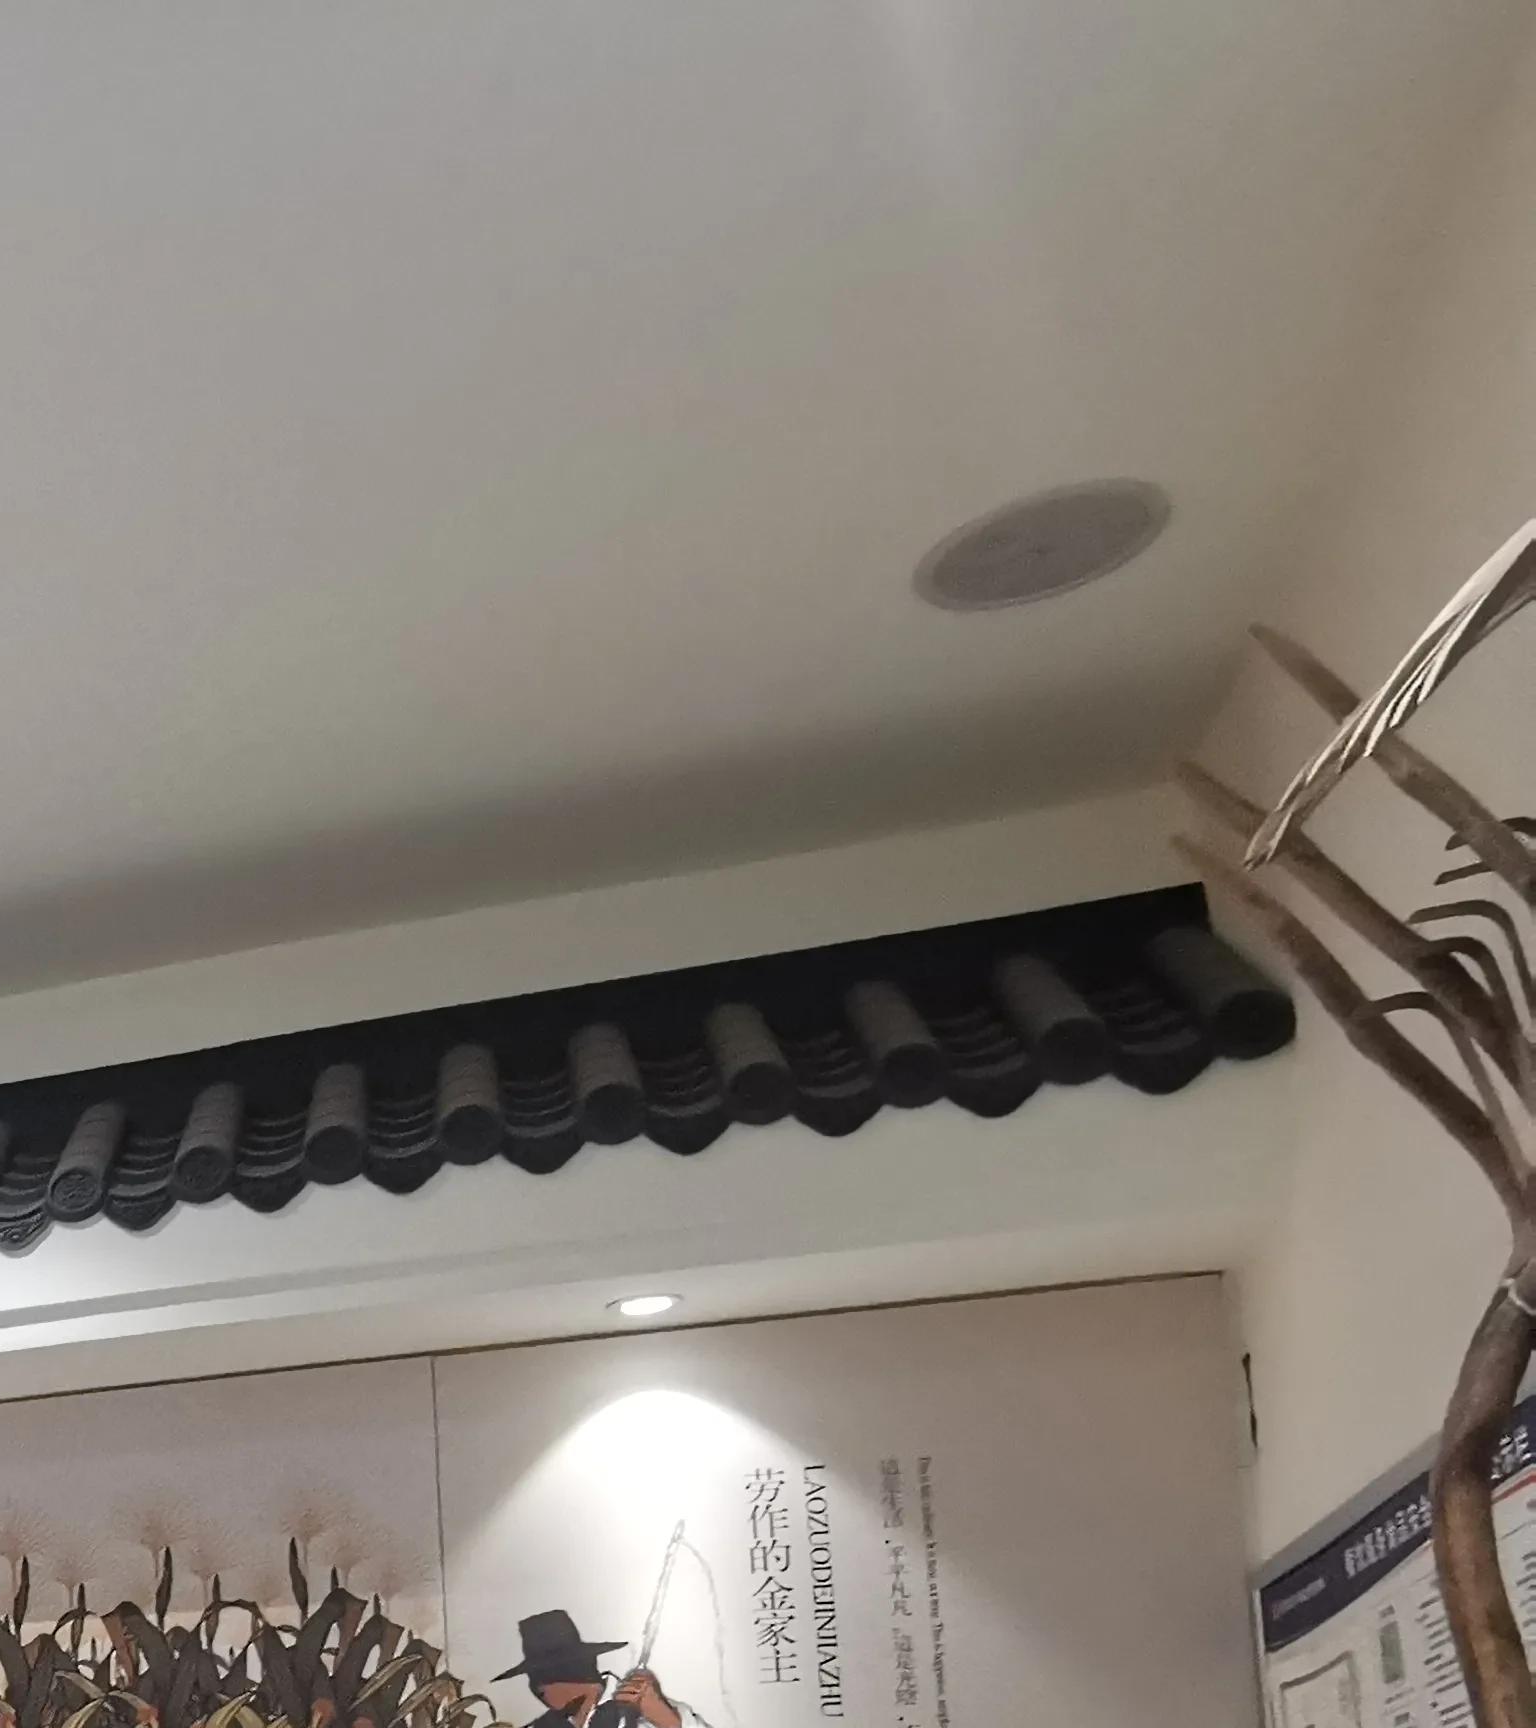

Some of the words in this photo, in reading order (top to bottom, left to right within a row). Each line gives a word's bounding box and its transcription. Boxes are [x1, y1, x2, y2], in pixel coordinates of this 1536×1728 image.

[744, 1467, 801, 1685] 劳作的金家主
[804, 1464, 844, 1718] LAOZUODEJINJIAZHU
